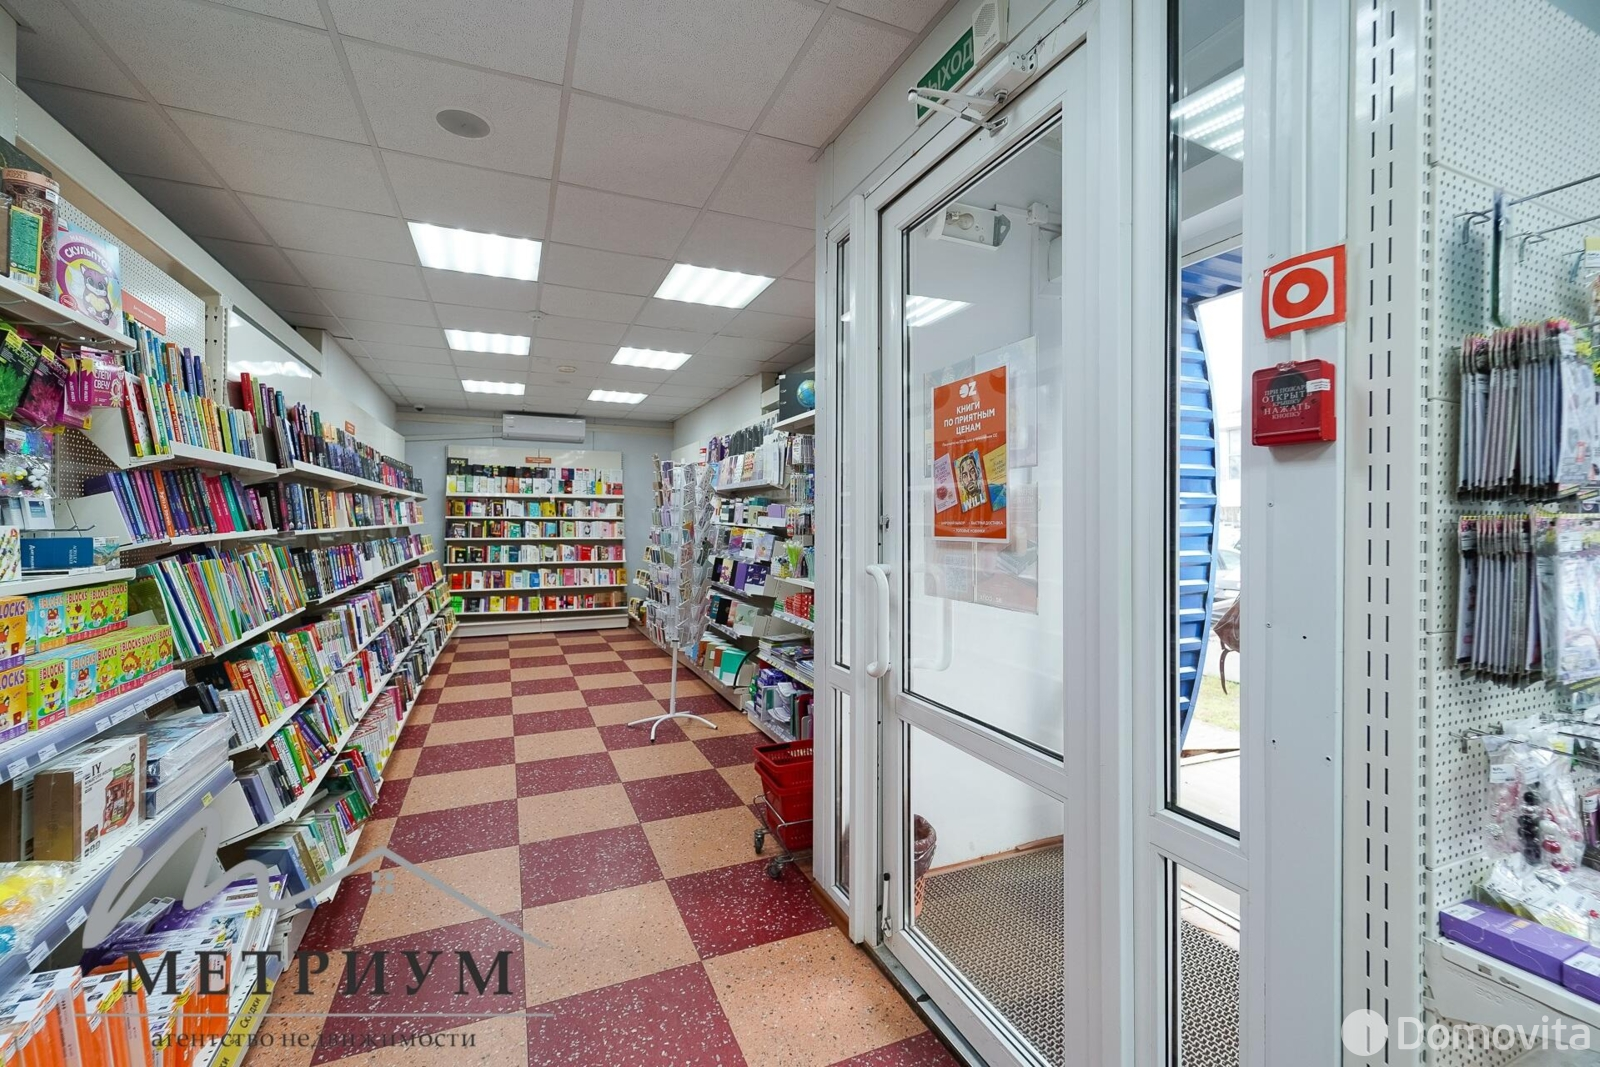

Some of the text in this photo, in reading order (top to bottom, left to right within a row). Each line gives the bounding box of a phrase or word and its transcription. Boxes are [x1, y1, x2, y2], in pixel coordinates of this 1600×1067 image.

[919, 36, 974, 108] ЫХОД
[959, 381, 977, 399] OZ
[1261, 390, 1313, 403] ОТКРЫТЬ
[1264, 388, 1279, 396] ПРИ
[1280, 384, 1307, 393] ПОЖАР
[956, 400, 980, 415] КНИГИ
[1264, 402, 1311, 415] НАЖАТЬ
[943, 407, 996, 428] ПО ПРИЯТНЫМ
[1271, 410, 1301, 420] КНОПКУ
[955, 422, 981, 435] ЦЕНАМ
[962, 494, 987, 512] WILL
[92, 587, 109, 600] BLOCKS
[112, 584, 128, 595] BLOCKS
[69, 590, 88, 604] BLOCKS
[142, 633, 157, 646] BLOCKS
[160, 629, 172, 640] BLOCKS
[123, 638, 141, 652] BLOCKS
[98, 645, 117, 660] BLOCKS
[42, 662, 64, 679] BLOCKS
[0, 669, 25, 689] OCKS
